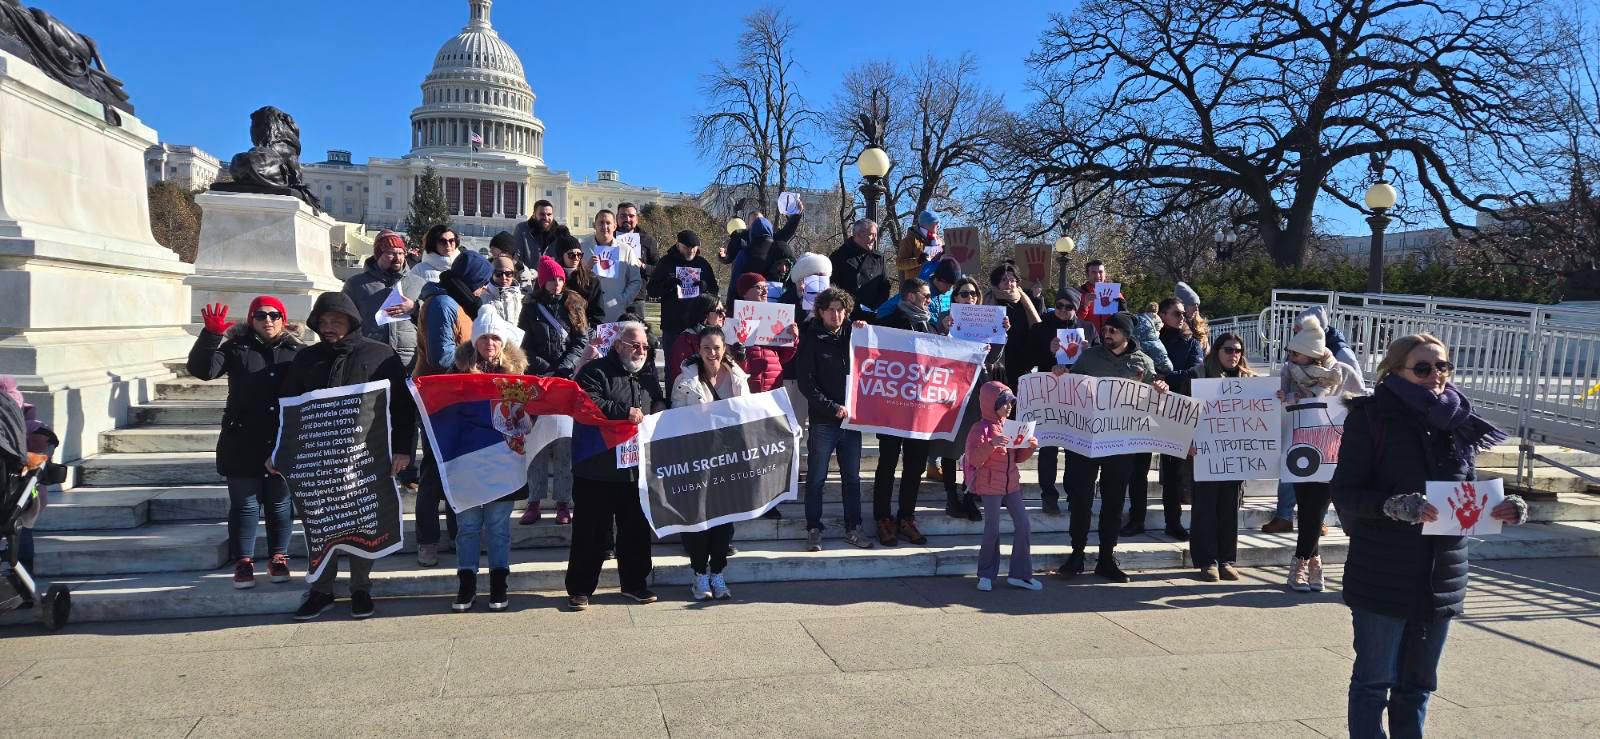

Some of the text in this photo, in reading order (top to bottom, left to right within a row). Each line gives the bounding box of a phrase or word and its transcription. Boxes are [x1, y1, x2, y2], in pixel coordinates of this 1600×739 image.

[860, 358, 952, 386] CEO SVET
[860, 378, 958, 406] VAS GLEDA
[1222, 380, 1242, 395] ИЗ
[1096, 379, 1200, 428] СТУДЕНТИМА
[340, 426, 363, 435] (2014)
[1204, 417, 1268, 434] ТЕТКА
[324, 448, 345, 457] Milica
[1195, 439, 1277, 455] НА ПРОТЕСТЕ
[323, 457, 348, 466] Mileva
[656, 441, 786, 479] SVIM SRCEM UZ VAS
[1209, 457, 1267, 474] ШЕТКА
[334, 464, 354, 474] Sanja
[317, 476, 342, 486] Stefan
[672, 464, 776, 494] LJUBAV ZA STUDENTE
[335, 510, 358, 519] Vasko
[322, 520, 356, 532] Goranka
